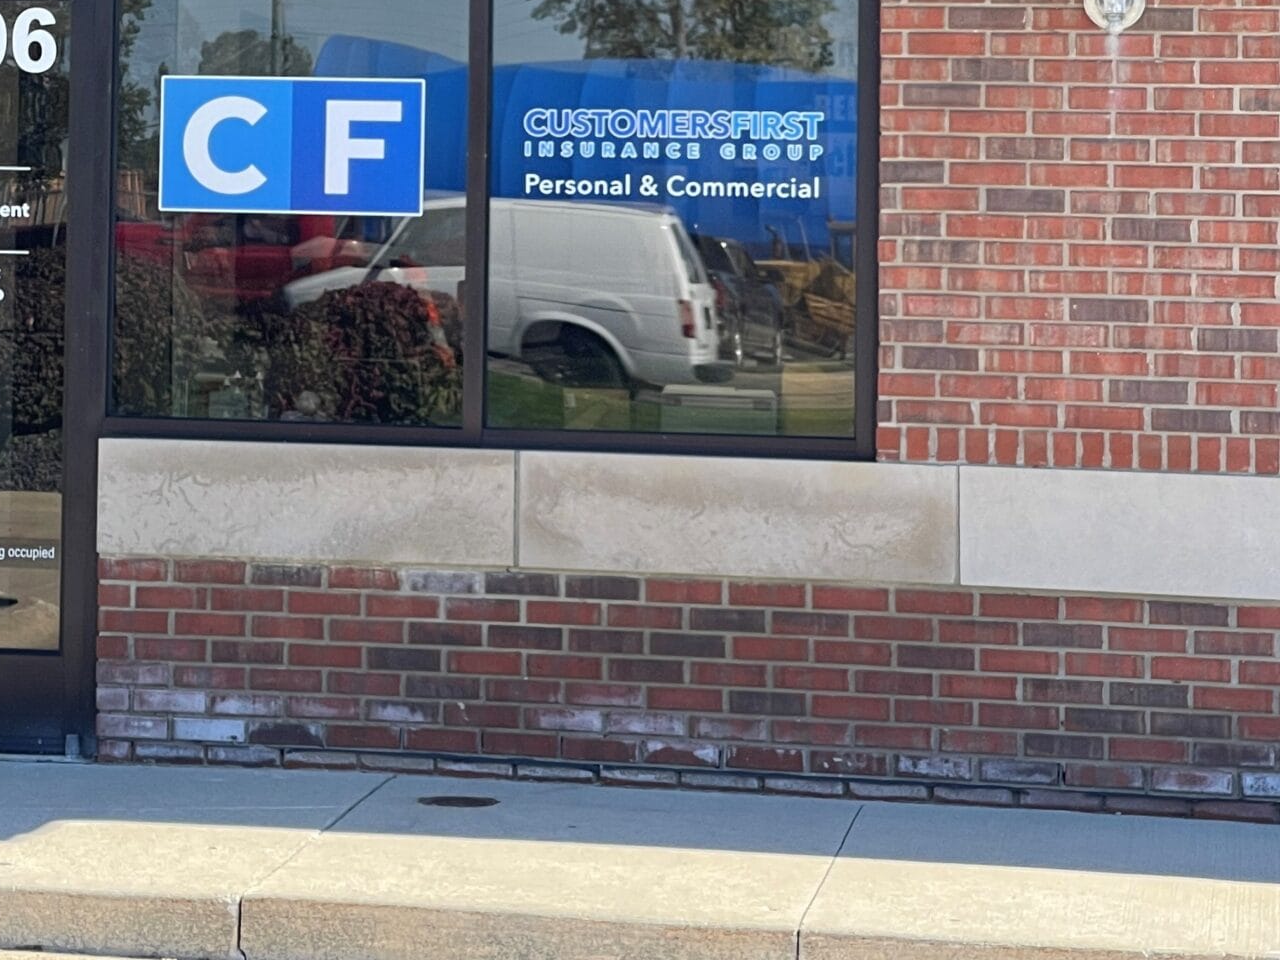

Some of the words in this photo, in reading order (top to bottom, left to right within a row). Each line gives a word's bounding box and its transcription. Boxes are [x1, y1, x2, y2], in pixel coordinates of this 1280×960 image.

[523, 108, 824, 141] CUSTOMERSFIRST
[524, 141, 700, 159] INSURANCE
[720, 143, 824, 161] GROUP
[525, 174, 631, 196] Personal
[639, 175, 659, 197] &
[667, 176, 820, 199] Commercial
[8, 546, 55, 560] occupied
